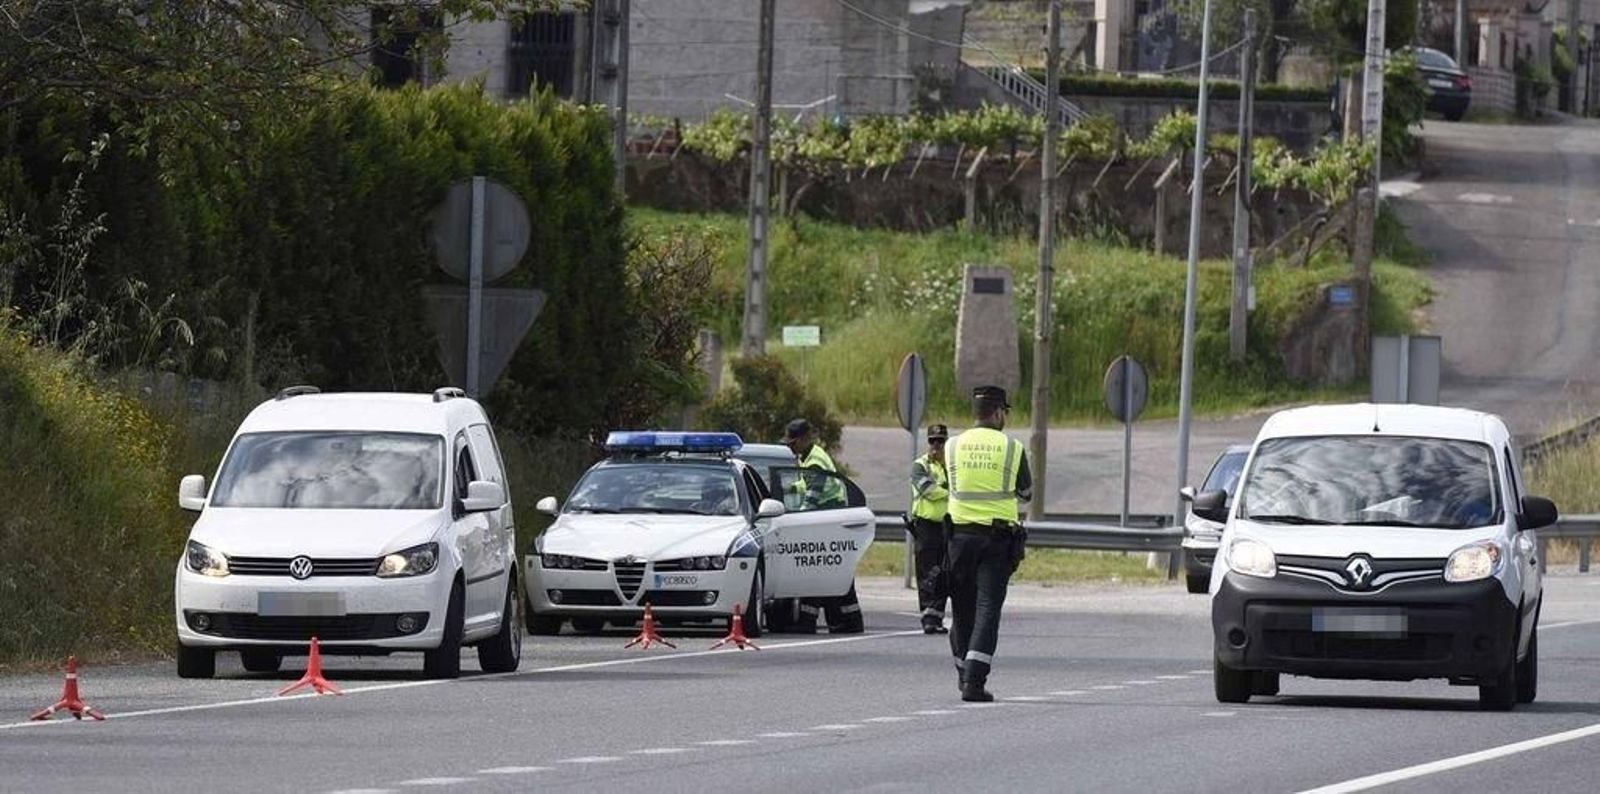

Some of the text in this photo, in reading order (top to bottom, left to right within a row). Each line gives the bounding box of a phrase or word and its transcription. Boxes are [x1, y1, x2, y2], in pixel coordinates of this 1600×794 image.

[961, 443, 1002, 452] GUARDIA
[969, 452, 992, 460] CIVIL
[963, 461, 998, 470] TRAFICO
[776, 540, 858, 554] GUARDIA CIVIL
[794, 554, 842, 567] TRAFICO
